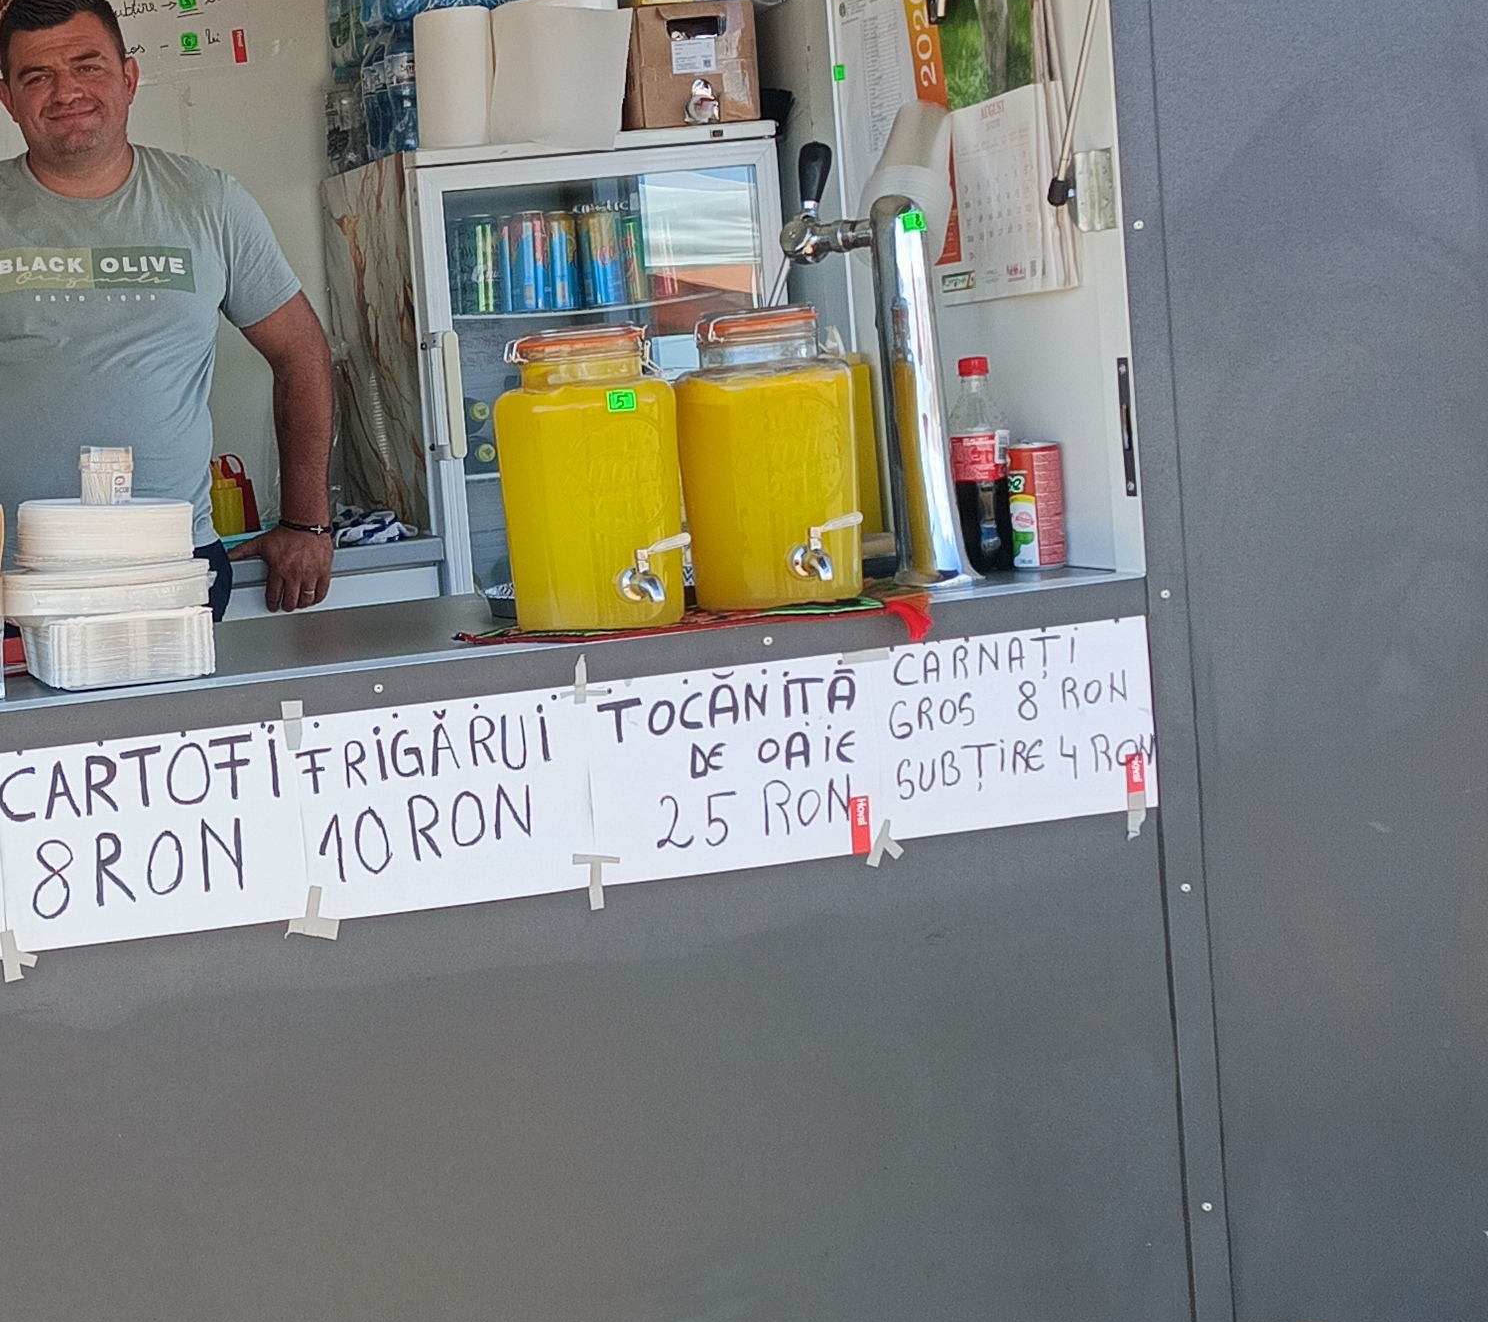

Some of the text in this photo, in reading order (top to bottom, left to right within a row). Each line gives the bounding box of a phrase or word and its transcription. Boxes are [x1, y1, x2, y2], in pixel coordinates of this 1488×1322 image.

[915, 213, 922, 227] 8
[15, 272, 172, 289] Originals
[100, 256, 187, 275] OLIVE
[616, 394, 629, 409] 5
[888, 669, 1128, 740] GROS 8 RON
[295, 703, 552, 794] FRIGĂRUI
[690, 724, 857, 779] DE OAIE
[1059, 734, 1078, 779] 4
[1090, 733, 1155, 773] RON
[318, 784, 532, 883] 10 RON
[655, 773, 852, 850] 25 RON
[857, 798, 867, 827] Hoval
[32, 817, 246, 920] 8 RON
